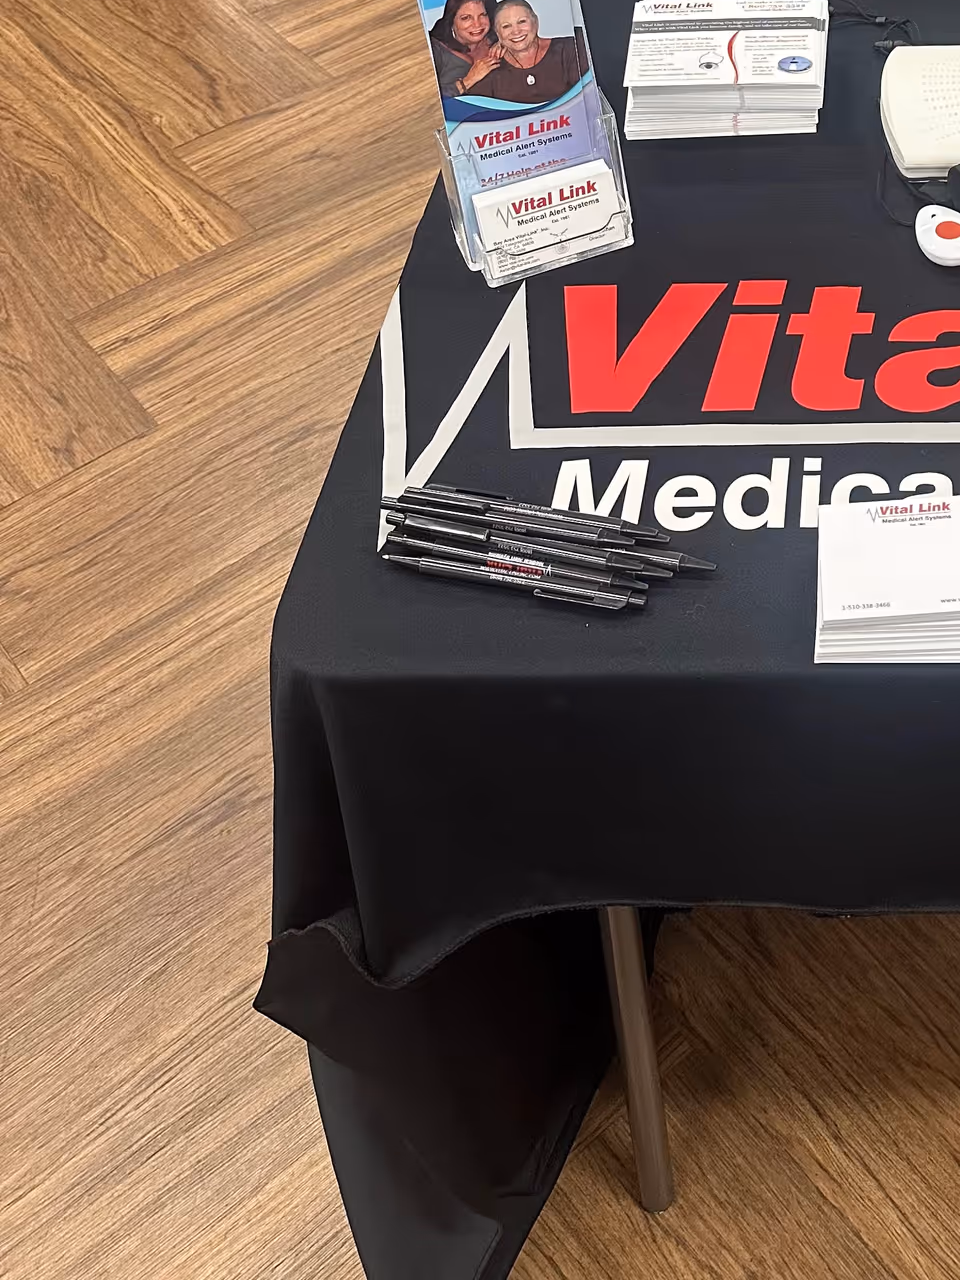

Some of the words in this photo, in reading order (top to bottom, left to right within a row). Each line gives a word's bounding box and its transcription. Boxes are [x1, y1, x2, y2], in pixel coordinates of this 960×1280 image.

[653, 2, 682, 10] Vital
[474, 125, 521, 149] Vital
[528, 114, 572, 136] Link
[480, 147, 514, 161] Medical
[515, 141, 535, 152] Alert
[537, 131, 573, 146] Systems
[511, 191, 552, 215] Vital
[559, 180, 598, 202] Link
[517, 212, 547, 227] Medical
[549, 207, 566, 218] Alert
[568, 197, 600, 212] Systems
[880, 503, 914, 516] Vital
[918, 501, 951, 513] Link
[924, 514, 952, 522] Systems
